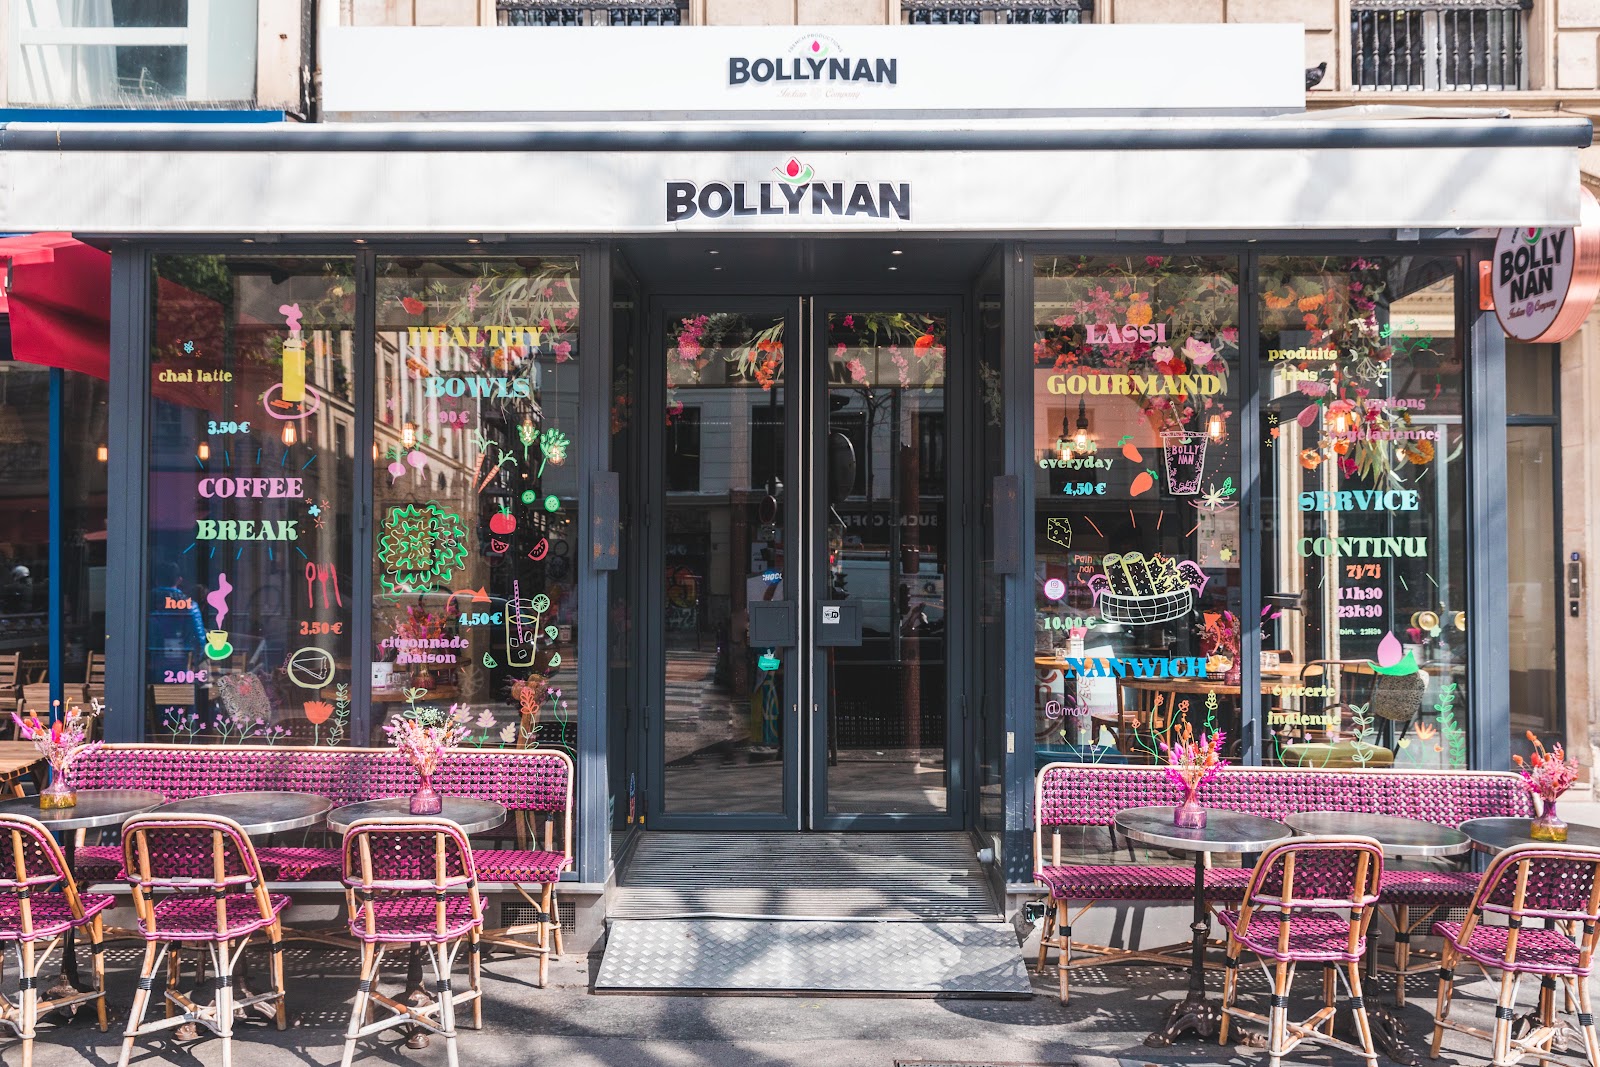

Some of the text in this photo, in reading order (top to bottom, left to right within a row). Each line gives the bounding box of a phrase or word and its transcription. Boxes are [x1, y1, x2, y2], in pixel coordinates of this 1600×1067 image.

[729, 57, 897, 85] BOLLYNAN
[665, 181, 910, 222] BOLLYNAN
[1500, 229, 1566, 286] BOLLY
[1510, 267, 1552, 304] NAN
[407, 325, 545, 347] HEALTHY
[1085, 323, 1167, 344] LASSI
[1267, 346, 1338, 361] produits
[158, 368, 233, 382] chai latte
[424, 377, 530, 398] BOWLS
[1047, 374, 1221, 395] GOURMAND
[207, 420, 251, 435] 3,50€
[1056, 438, 1097, 451] fresh
[1171, 445, 1199, 455] BOLLY
[1039, 455, 1114, 471] everyday
[1178, 454, 1195, 465] NAN
[198, 477, 304, 498] COFFEE
[1297, 489, 1419, 511] SERVICE
[196, 519, 299, 541] BREAK
[1297, 536, 1428, 558] CONTINU
[1074, 554, 1093, 564] Pain
[1346, 563, 1382, 580] 7j/7j
[1338, 587, 1383, 600] 11h30
[165, 596, 192, 609] hot
[458, 611, 503, 626] 4,50€
[1337, 604, 1383, 618] 23h30
[300, 621, 343, 635] 3,50€
[381, 636, 470, 649] citronnade
[396, 651, 457, 665] maison
[1064, 657, 1208, 679] NANWICH
[164, 669, 208, 684] 2,00€
[1272, 684, 1337, 698] épicerie
[1267, 711, 1342, 726] indienne
